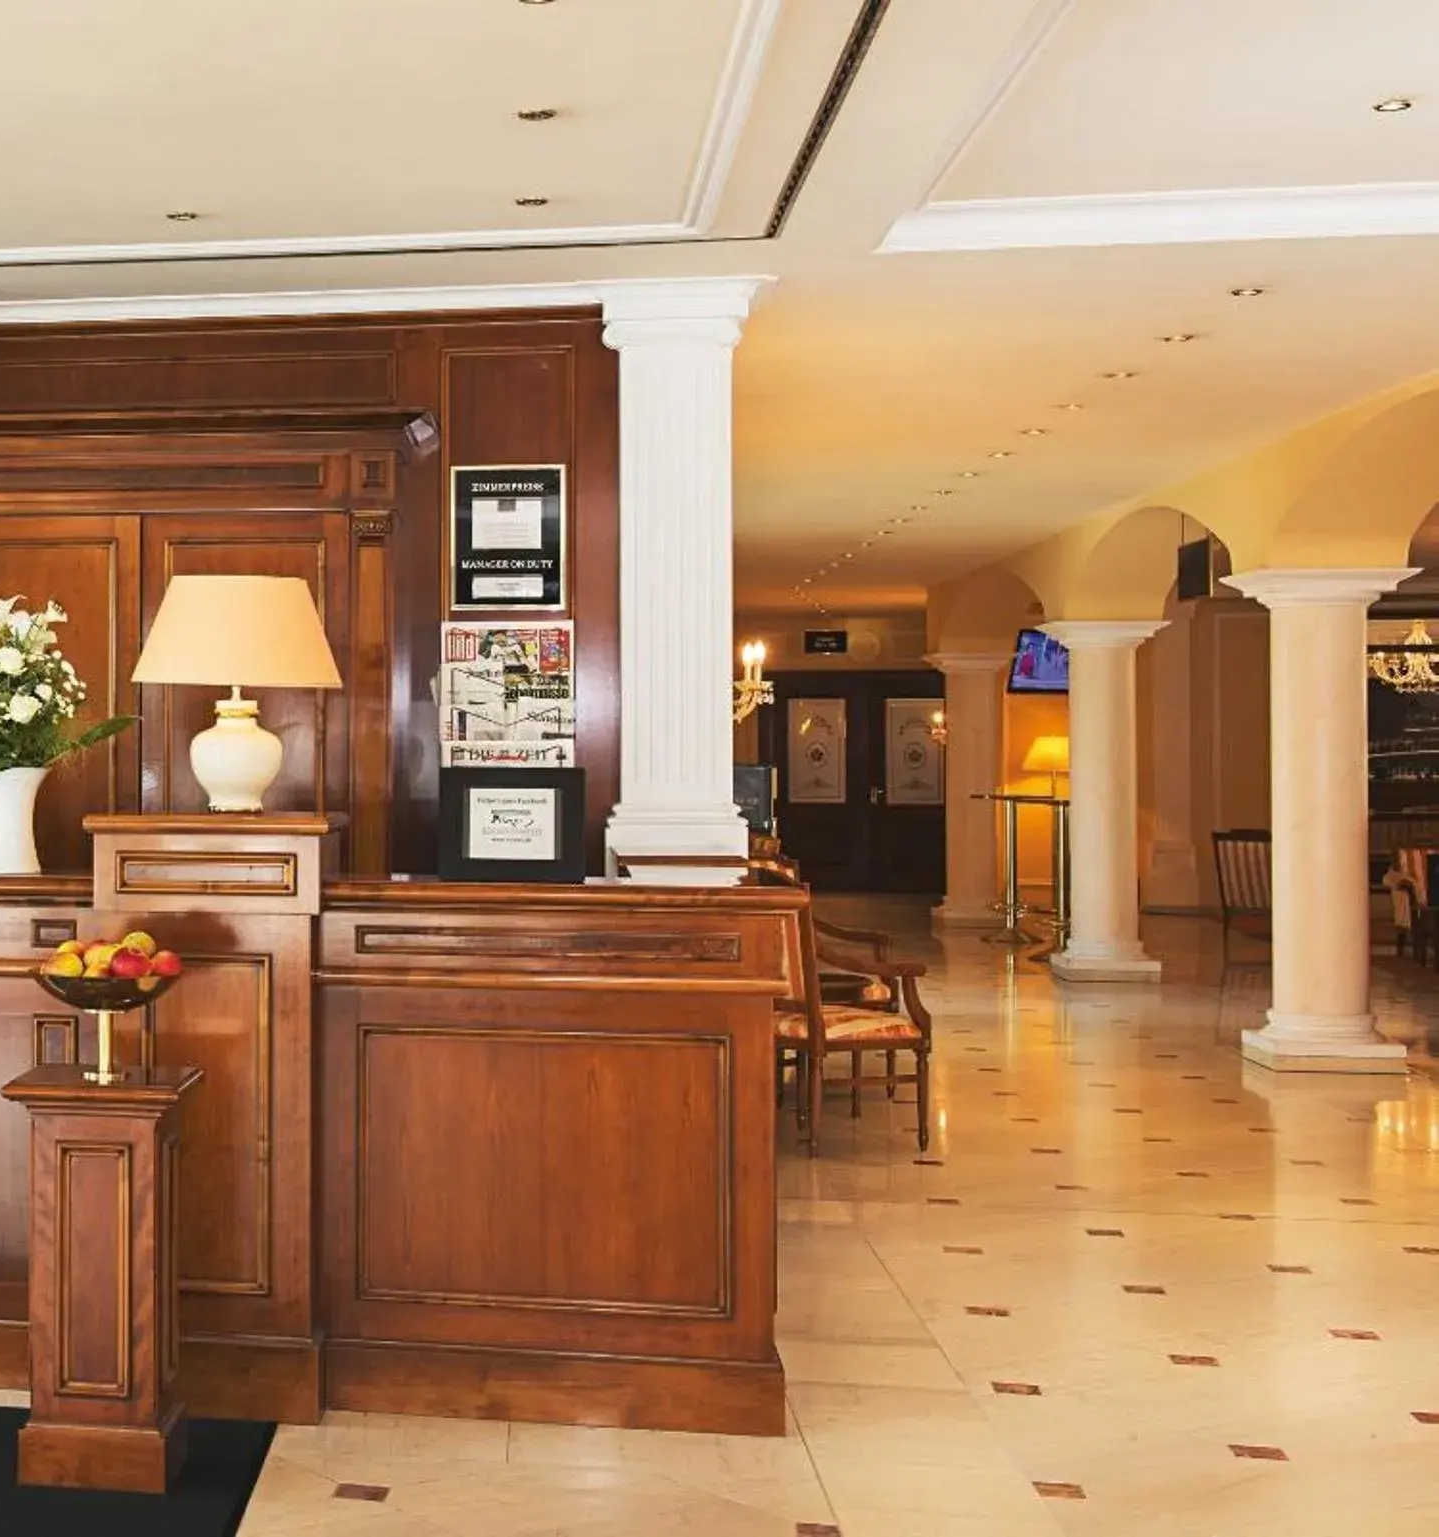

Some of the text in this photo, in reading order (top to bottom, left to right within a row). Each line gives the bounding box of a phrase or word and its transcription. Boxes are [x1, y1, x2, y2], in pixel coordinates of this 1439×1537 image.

[461, 559, 554, 569] MANAGER ON DUTY
